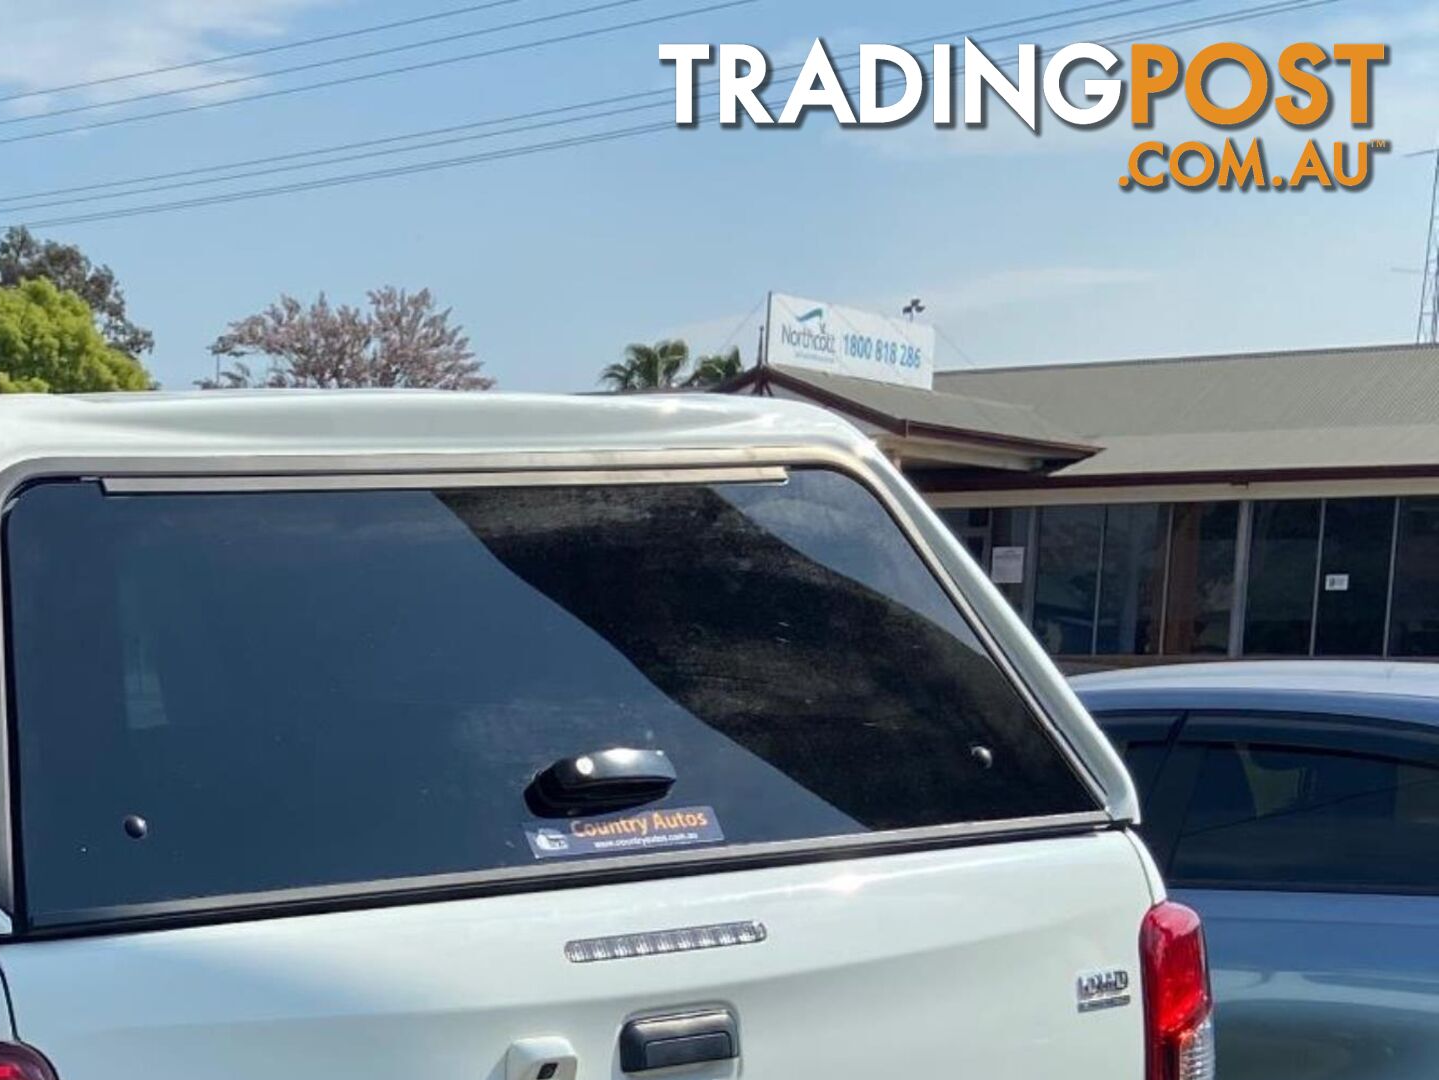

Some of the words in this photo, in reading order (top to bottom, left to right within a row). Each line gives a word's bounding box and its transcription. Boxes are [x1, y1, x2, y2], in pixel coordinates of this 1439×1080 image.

[781, 325, 835, 353] Northcott
[843, 333, 872, 360] 1800
[875, 338, 897, 366] 818
[899, 344, 921, 369] 286
[570, 814, 648, 838] Country
[651, 811, 708, 831] Autos
